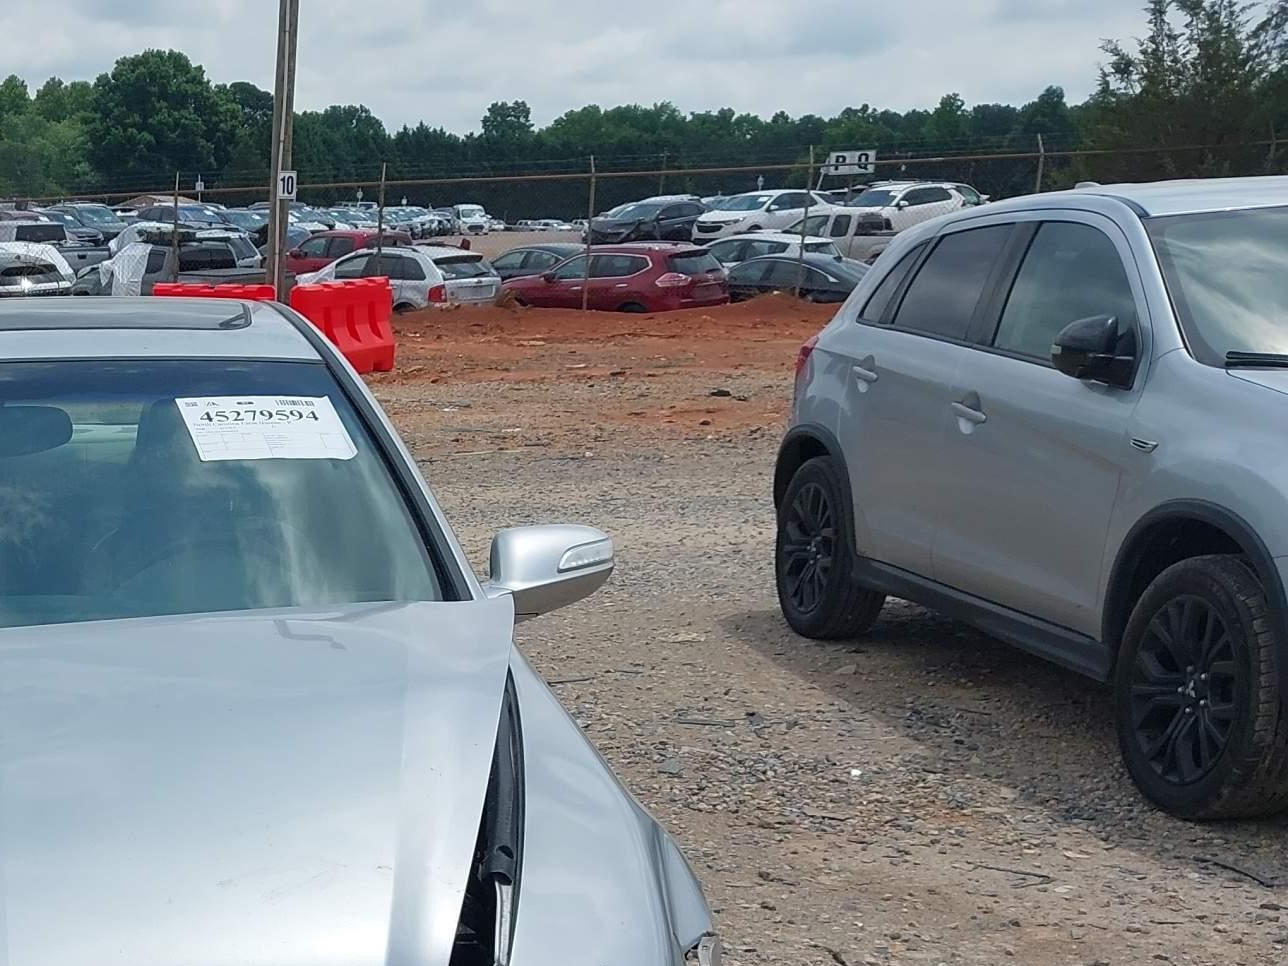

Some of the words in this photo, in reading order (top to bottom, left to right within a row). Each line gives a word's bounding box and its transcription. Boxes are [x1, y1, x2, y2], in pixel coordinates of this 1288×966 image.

[835, 155, 846, 171] P
[857, 153, 869, 170] Q
[280, 175, 294, 195] 10
[200, 409, 319, 423] 45279594
